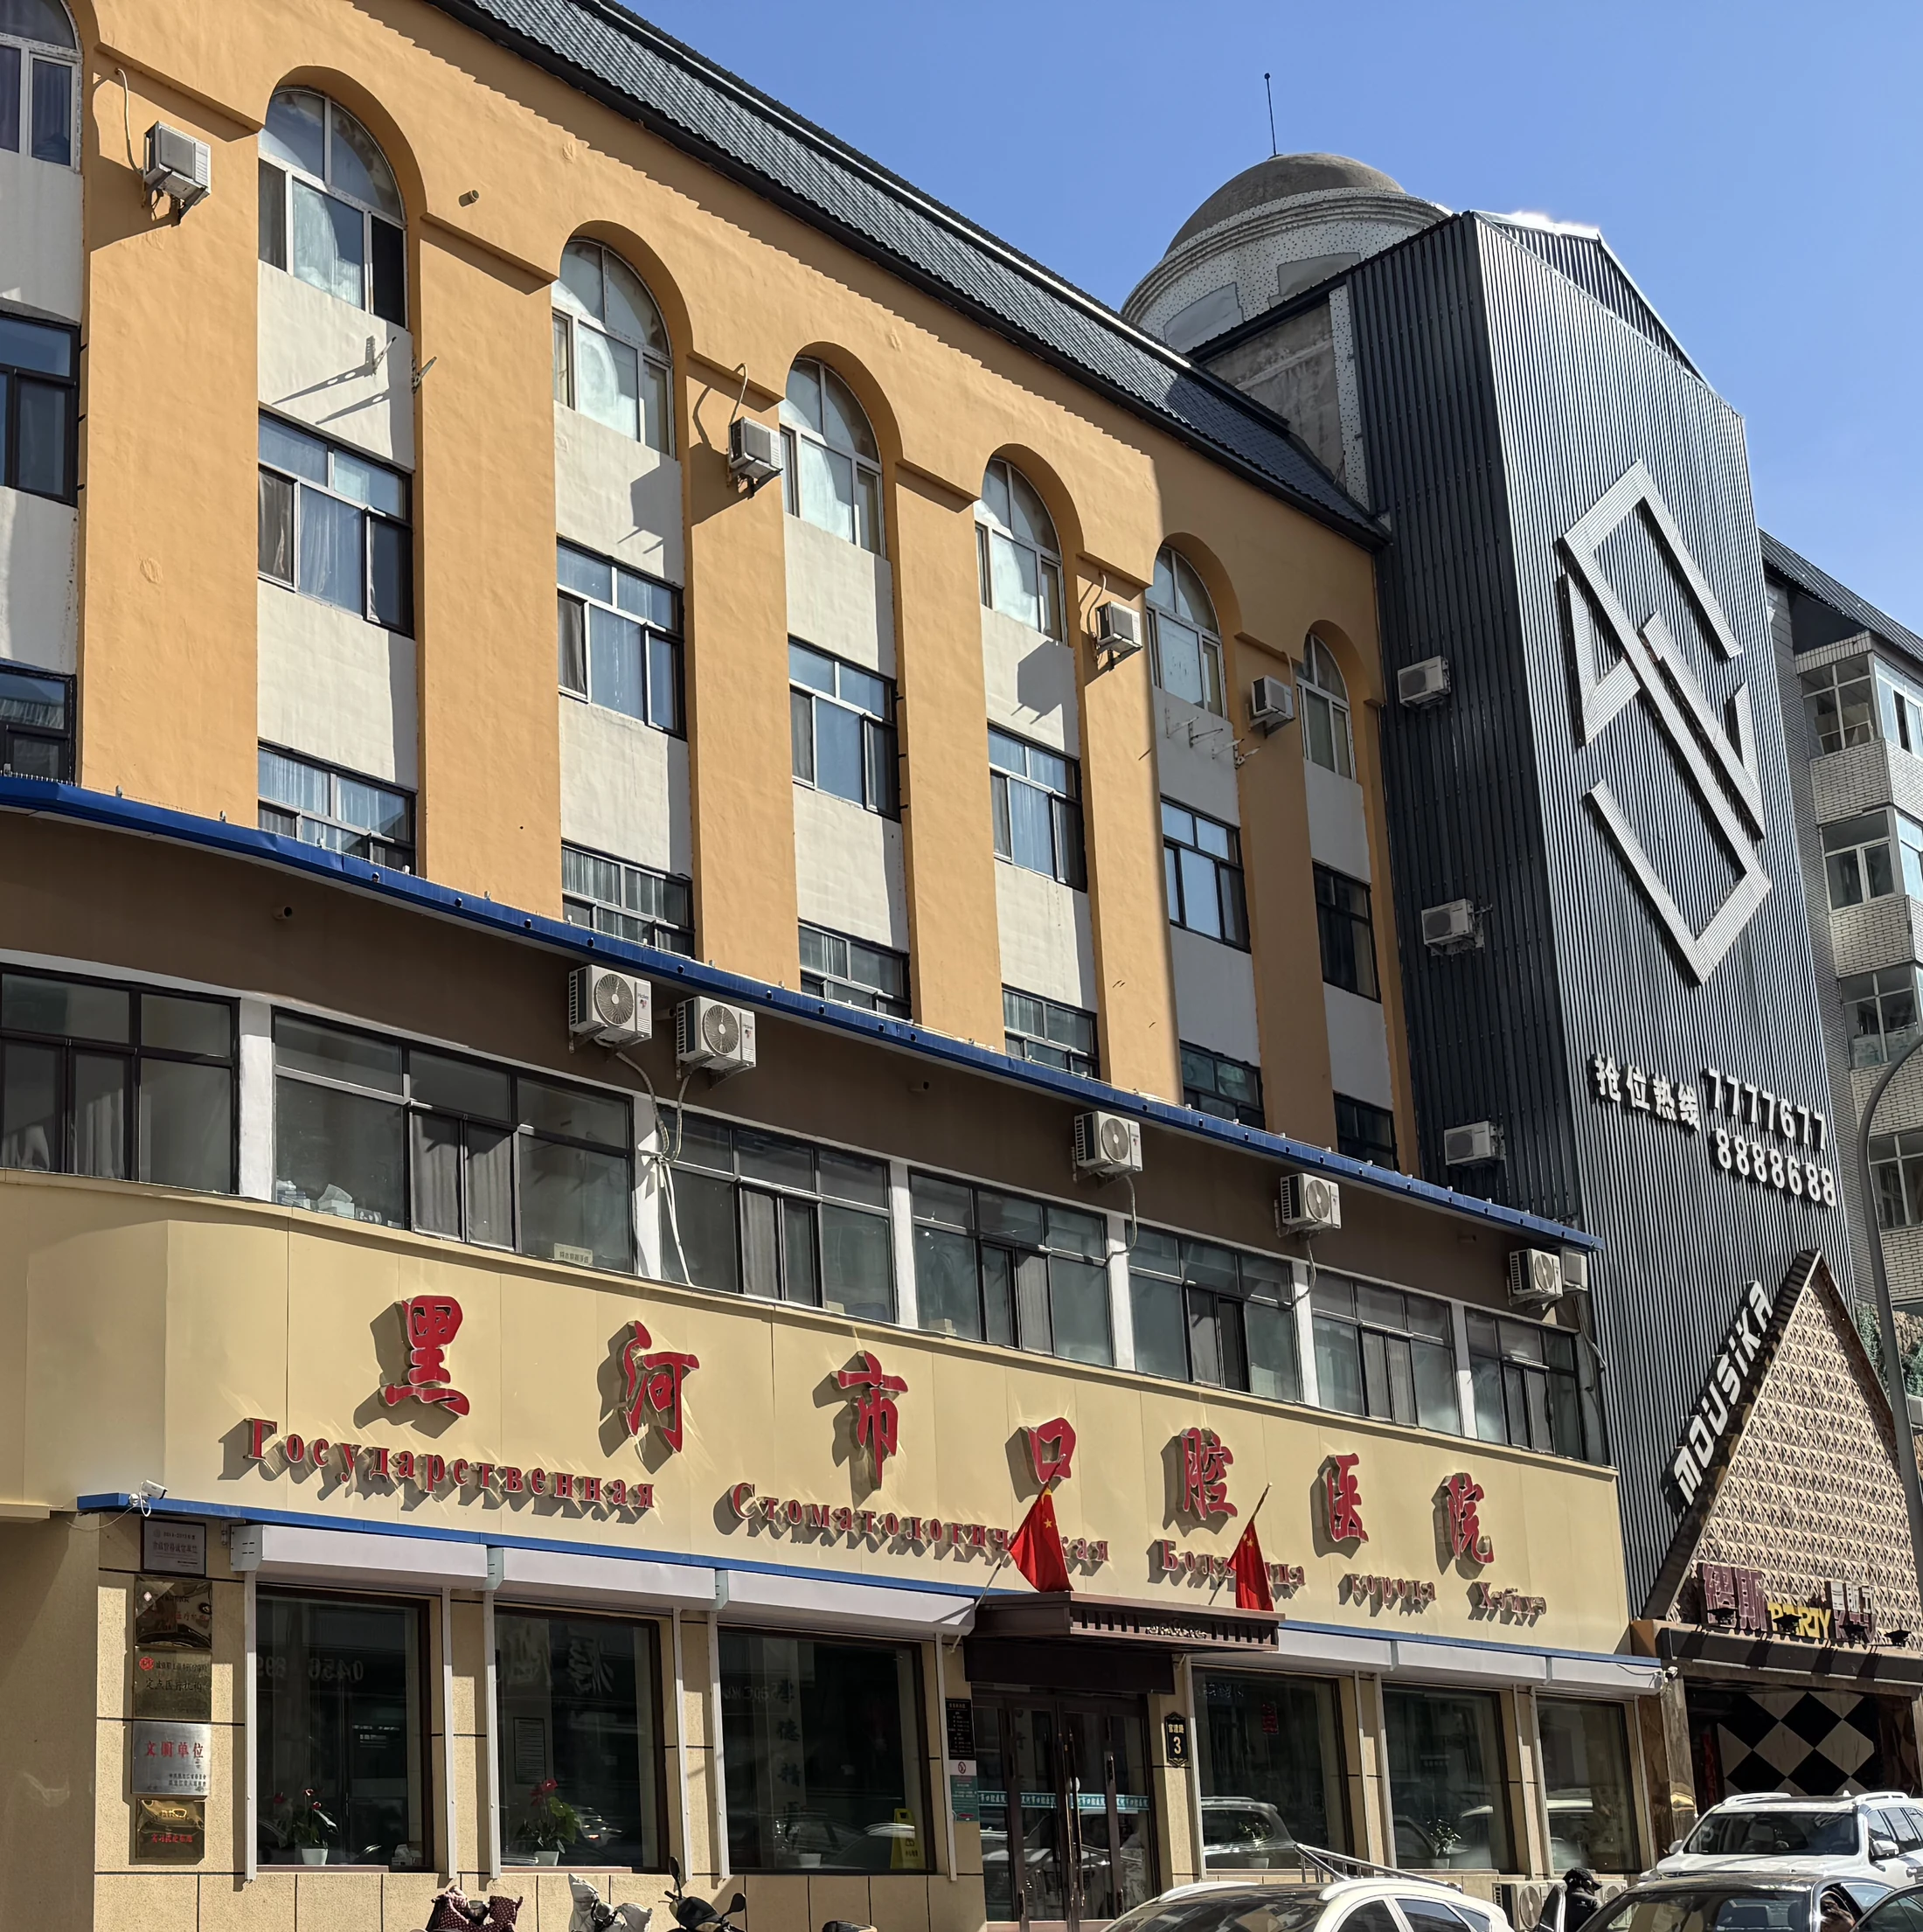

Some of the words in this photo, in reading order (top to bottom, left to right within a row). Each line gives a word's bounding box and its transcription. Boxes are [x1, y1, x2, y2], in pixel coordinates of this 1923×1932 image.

[1593, 1053, 1700, 1130] 抢位热线
[1704, 1068, 1827, 1150] 7777677
[1714, 1128, 1836, 1207] 8888688
[385, 1295, 1495, 1563] 黑河市口腔医院
[244, 1417, 655, 1509] Государственная
[732, 1483, 1109, 1562] Стоматологичкая
[1351, 1574, 1436, 1607] города
[145, 1740, 204, 1758] 文明单位
[1173, 1736, 1182, 1755] 3
